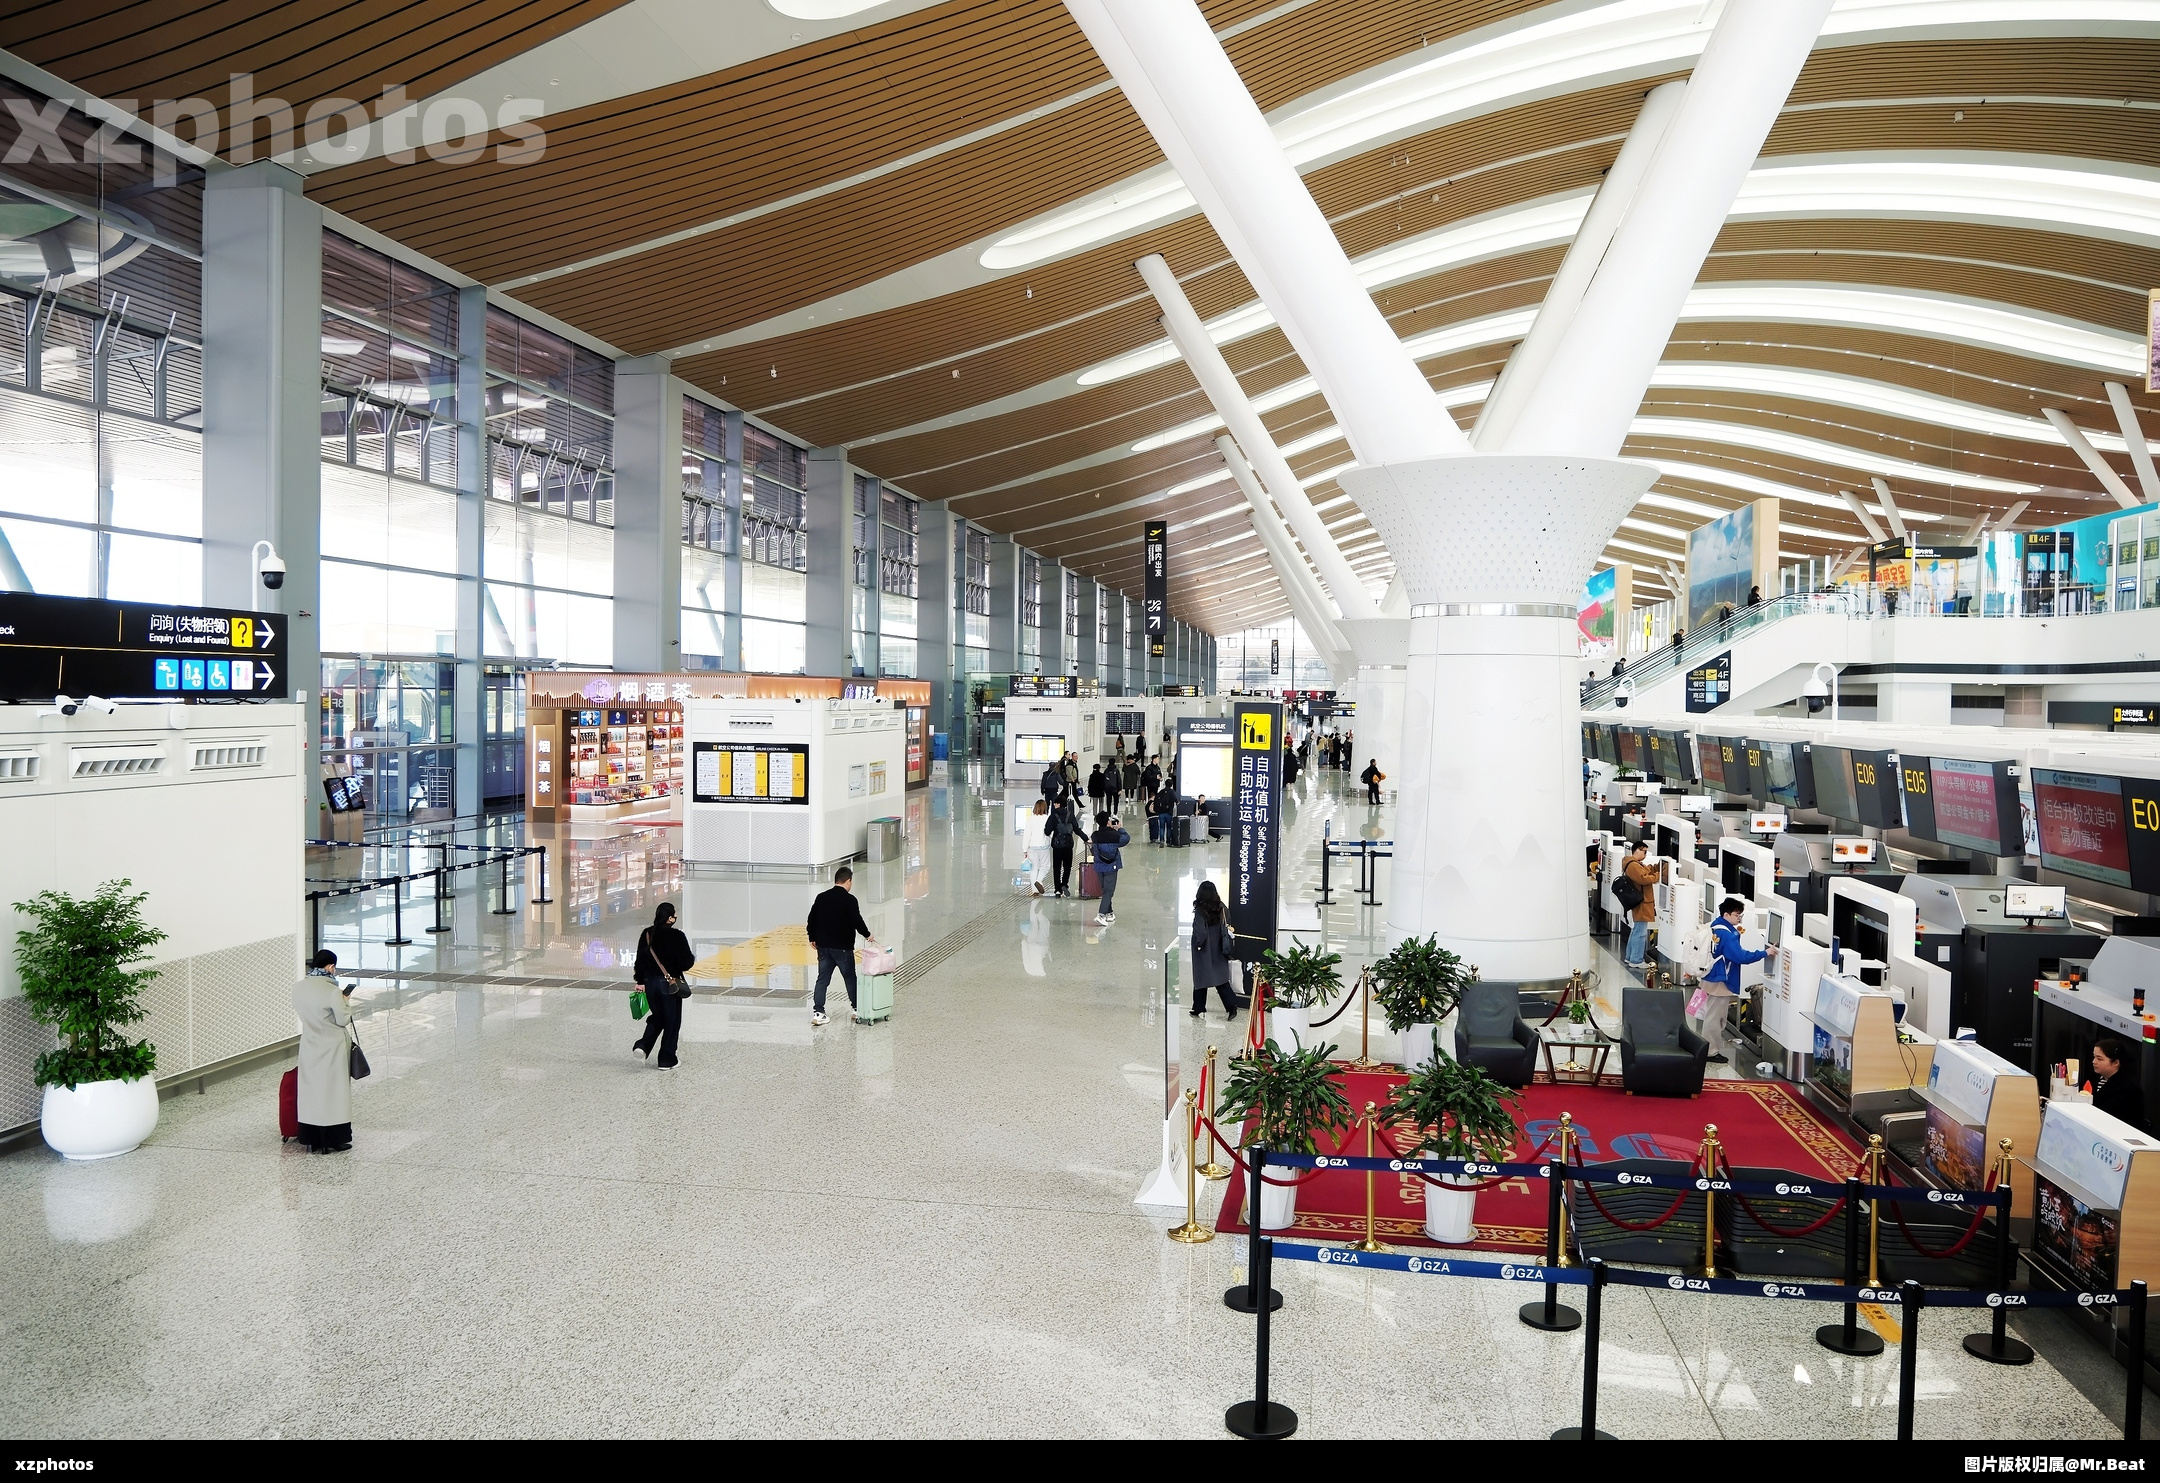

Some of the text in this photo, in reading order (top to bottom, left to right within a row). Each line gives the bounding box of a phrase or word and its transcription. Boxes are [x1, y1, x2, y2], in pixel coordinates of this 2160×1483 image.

[149, 633, 229, 645] Enquiry (Lost and Found)
[1718, 671, 1729, 679] 4F
[619, 682, 692, 702] 烟酒茶
[2149, 710, 2153, 721] 4
[1723, 746, 1734, 763] E08
[1749, 750, 1760, 767] E07
[538, 740, 550, 793] 烟酒茶
[1856, 763, 1875, 785] E06
[1239, 755, 1253, 822] 自助托运
[1905, 770, 1926, 794] E05
[1255, 756, 1269, 823] 自助值机
[2043, 798, 2117, 829] 柜台升级改造中
[2060, 826, 2103, 852] 请勿靠近
[1257, 826, 1266, 874] Self Check-in
[1239, 825, 1251, 904] Self Baggage Check-in
[1633, 1176, 1652, 1184] GZA
[1332, 1252, 1358, 1263] GZA
[1423, 1261, 1450, 1272] GZA
[1516, 1268, 1543, 1279] GZA
[1686, 1280, 1710, 1290] GZA
[1782, 1287, 1805, 1296] GZA
[1878, 1292, 1901, 1301] GZA
[2004, 1296, 2026, 1304] GZA
[2096, 1295, 2117, 1303] GZA
